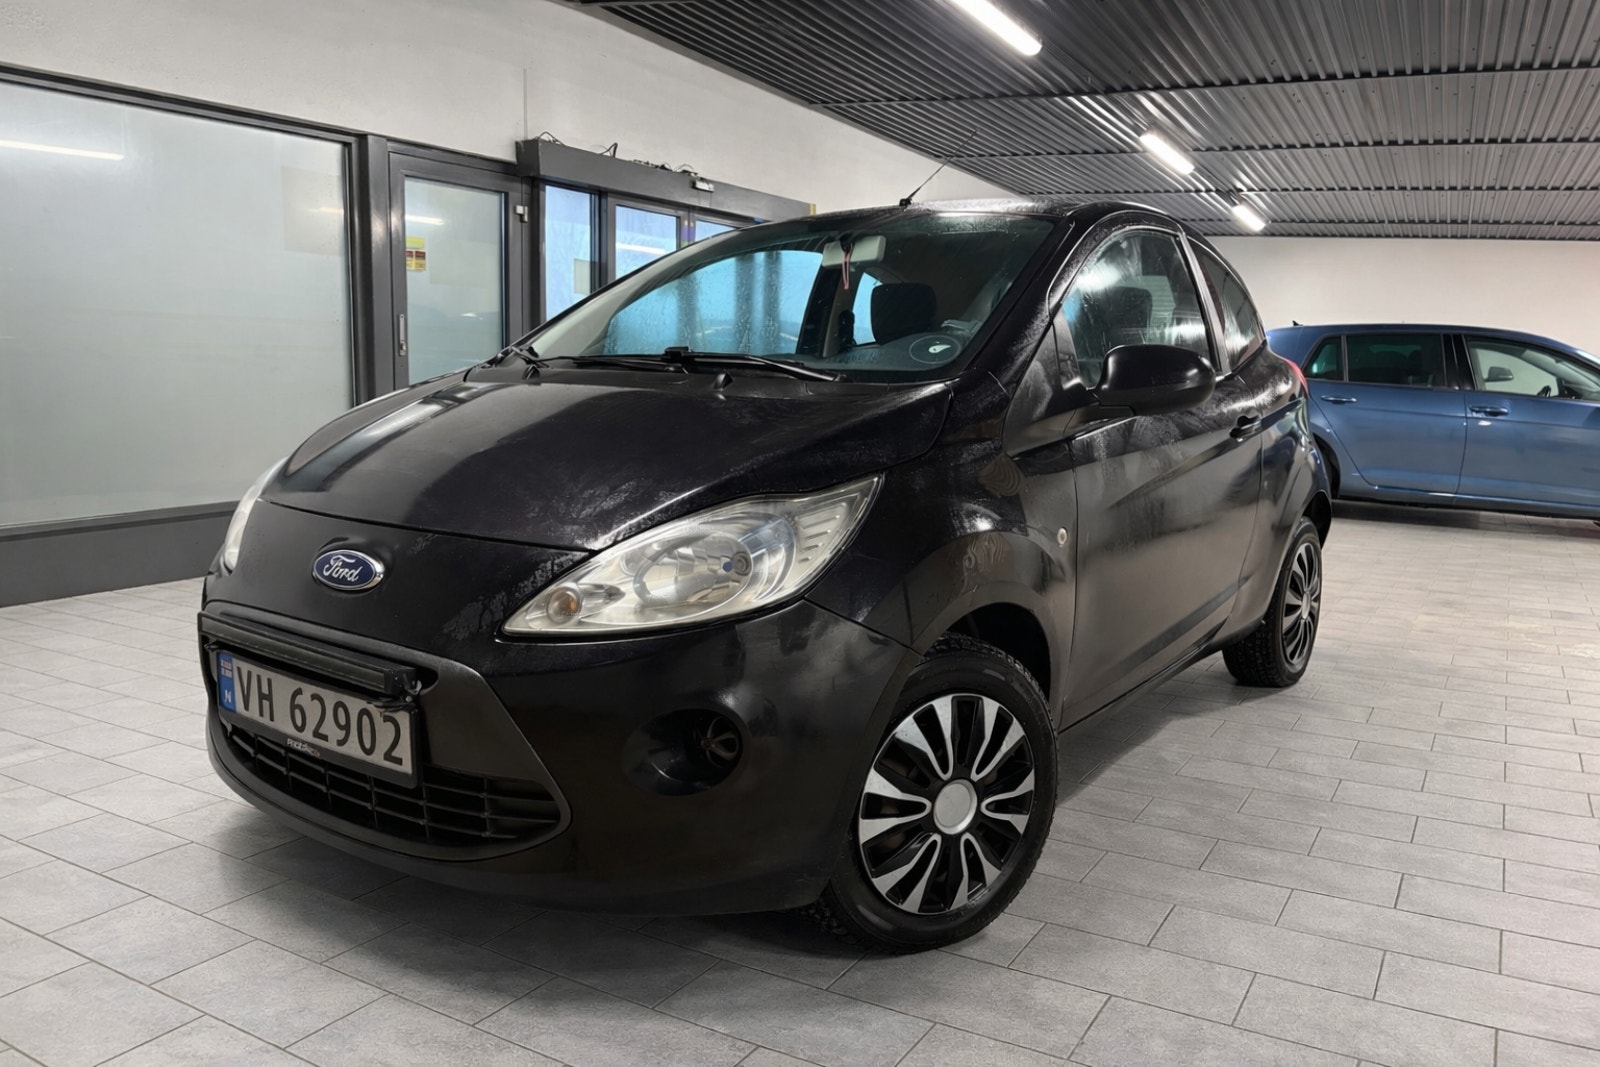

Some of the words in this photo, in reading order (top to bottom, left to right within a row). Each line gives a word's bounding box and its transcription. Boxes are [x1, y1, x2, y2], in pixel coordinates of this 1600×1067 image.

[323, 555, 363, 582] Ford
[237, 666, 275, 722] VH
[290, 687, 403, 766] 62902
